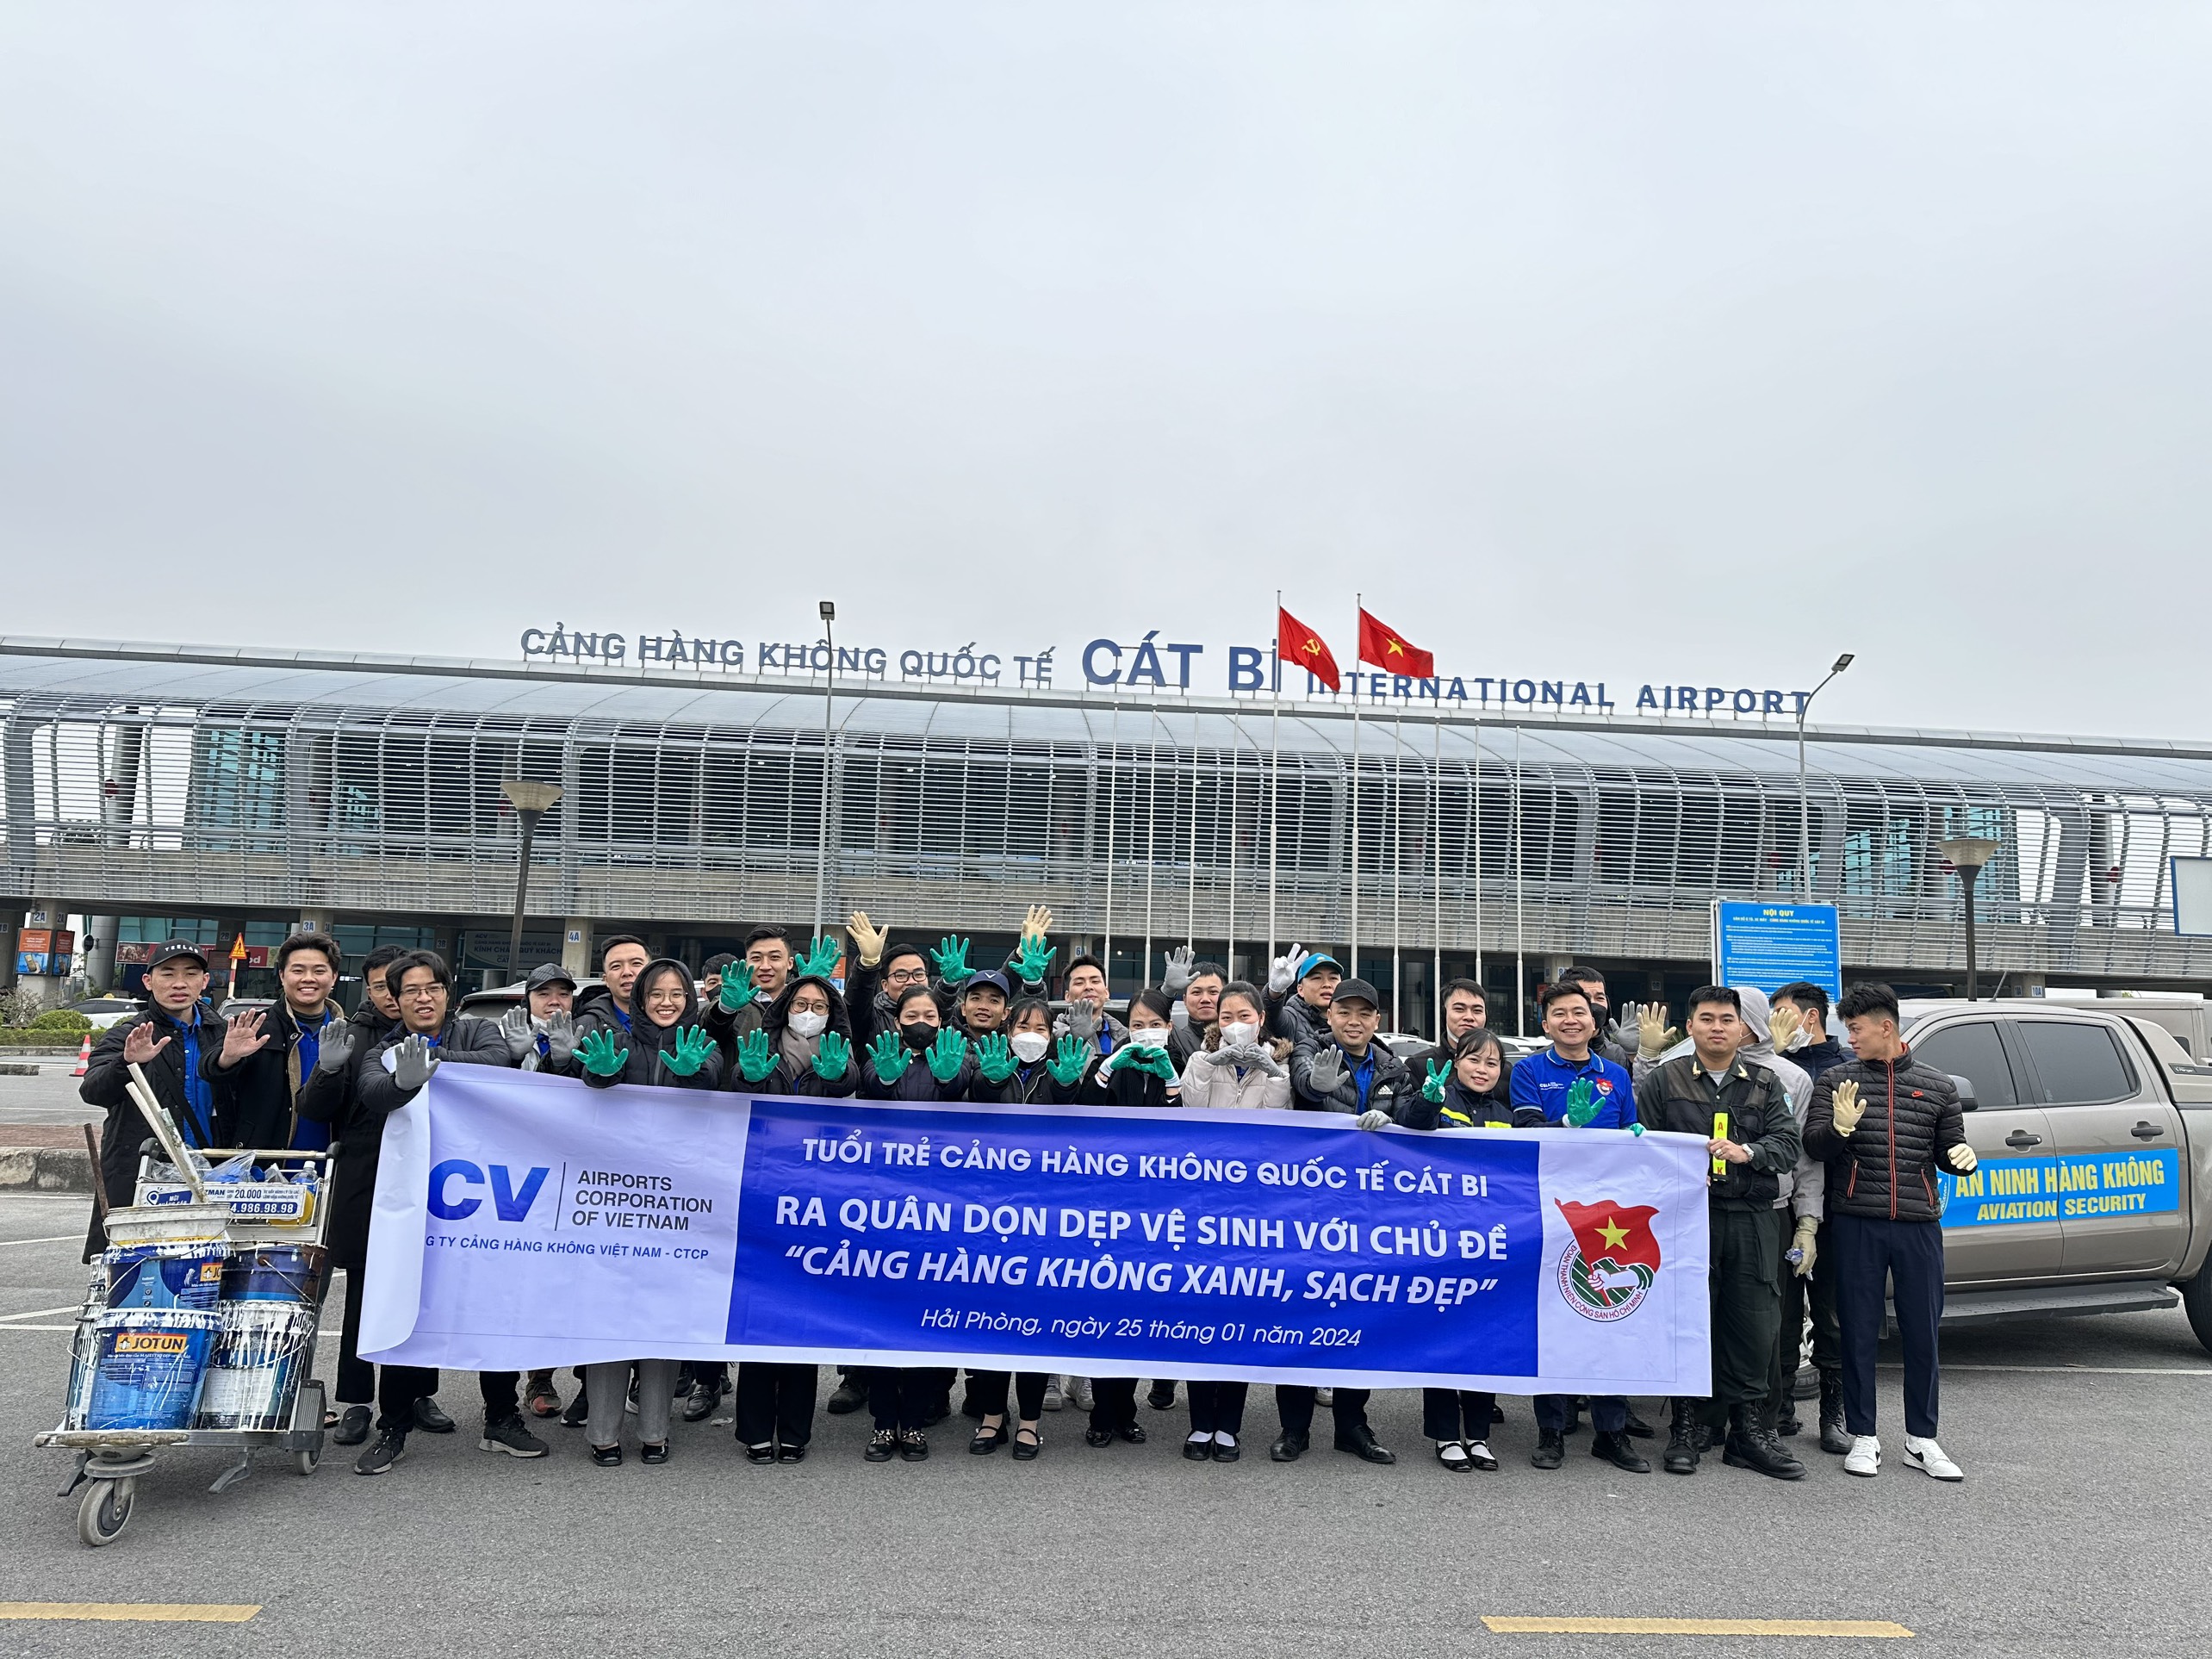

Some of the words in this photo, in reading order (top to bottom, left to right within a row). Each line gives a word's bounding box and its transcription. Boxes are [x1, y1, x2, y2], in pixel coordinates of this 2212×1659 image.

[520, 621, 626, 660] CẢNG
[637, 629, 744, 667] HÀNG
[758, 638, 887, 674] KHÔNG
[899, 641, 1002, 680] QUỐC
[1013, 645, 1057, 683] TẾ
[1081, 631, 1203, 689] CÁT
[1635, 684, 1811, 715] AIRPORT
[34, 912, 46, 921] 2A
[303, 921, 314, 931] 3A
[569, 931, 580, 941] 4A
[2032, 986, 2042, 997] 10A
[1717, 1122, 1724, 1131] A
[802, 1128, 873, 1165] TUỔI
[881, 1136, 932, 1167] TRẺ
[940, 1139, 1032, 1171] CẢNG
[1040, 1145, 1129, 1177] HÀNG
[1138, 1151, 1248, 1184] KHÔNG
[1257, 1155, 1347, 1190] QUỐC
[1355, 1159, 1390, 1191] TẾ
[1393, 1165, 1452, 1196] CÁT
[1462, 1174, 1488, 1197] BI
[1717, 1166, 1724, 1175] K
[577, 1170, 673, 1191] AIRPORTS
[1955, 1169, 1984, 1198] AN
[1990, 1167, 2040, 1196] NINH
[2045, 1160, 2098, 1193] HÀNG
[2103, 1156, 2165, 1189] KHÔNG
[234, 1189, 262, 1199] 20.000
[575, 1190, 713, 1213] CORPORATION
[1977, 1199, 2057, 1221] AVIATION
[2064, 1193, 2147, 1215] SECURITY
[571, 1209, 598, 1227] OF
[604, 1211, 690, 1231] VIETNAM
[775, 1196, 828, 1227] RA
[838, 1195, 952, 1233] QUÂN
[963, 1203, 1047, 1243] DỌN
[1059, 1209, 1131, 1247] DẸP
[1140, 1208, 1187, 1252] VỆ
[1196, 1215, 1284, 1249] SINH
[1293, 1217, 1359, 1252] VỚI
[1369, 1220, 1448, 1258] CHỦ
[1457, 1223, 1508, 1261] ĐỀ
[438, 1236, 457, 1248] TY
[460, 1233, 500, 1250] CẢNG
[503, 1237, 543, 1252] HÀNG
[546, 1240, 596, 1256] KHÔNG
[600, 1243, 630, 1258] VIỆT
[632, 1246, 662, 1258] NAM
[674, 1247, 710, 1260] CTCP
[916, 1246, 1028, 1286] HÀNG
[1035, 1253, 1173, 1293] KHÔNG
[1179, 1264, 1295, 1302] XANH,
[1302, 1271, 1401, 1308] SẠCH
[1560, 1262, 1569, 1286] THANH
[1630, 1291, 1643, 1308] MINH
[920, 1307, 960, 1329] Hải
[964, 1310, 1043, 1335] Phòng,
[1049, 1317, 1111, 1339] ngày
[1115, 1318, 1143, 1337] 25
[1148, 1320, 1216, 1345] tháng
[1221, 1323, 1246, 1342] 01
[1252, 1325, 1304, 1345] năm
[1308, 1327, 1363, 1347] 2024
[132, 1336, 183, 1350] JOTUN
